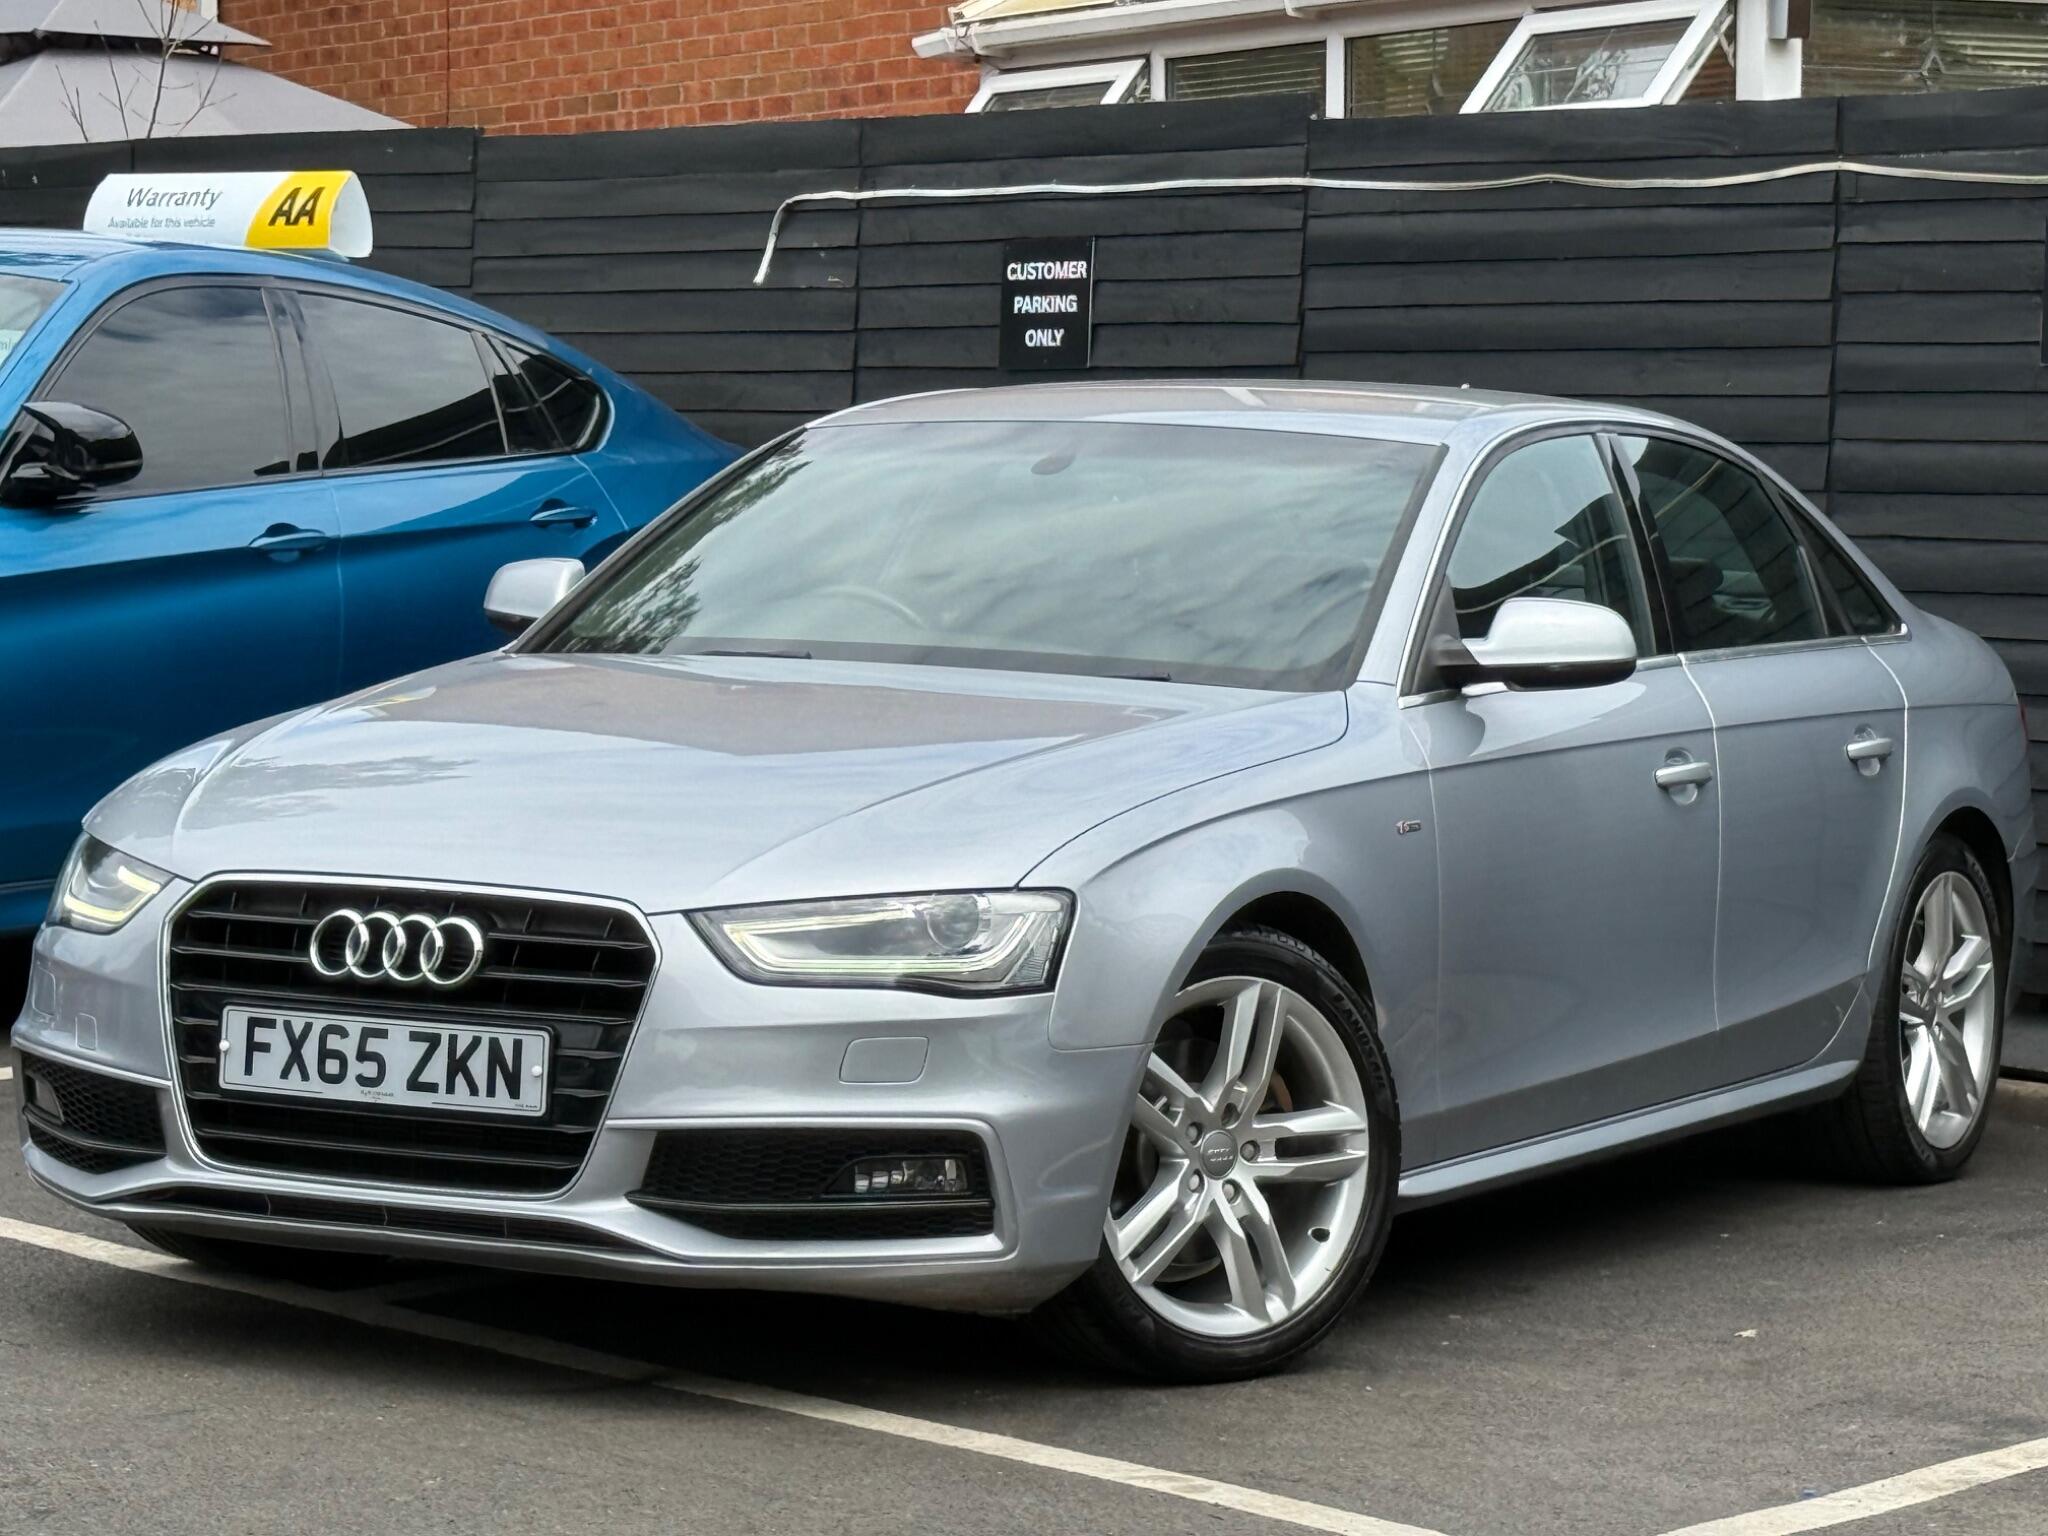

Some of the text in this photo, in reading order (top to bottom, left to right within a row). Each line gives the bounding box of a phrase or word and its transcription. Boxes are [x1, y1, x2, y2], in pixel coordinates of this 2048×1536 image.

[127, 187, 223, 211] Warranty
[268, 186, 326, 227] AA
[108, 215, 216, 229] Available for this vehicle
[1006, 260, 1088, 281] CUSTOMER
[1013, 294, 1079, 314] PARKING
[1024, 328, 1065, 348] ONLY
[243, 1016, 524, 1100] FX65 ZKN
